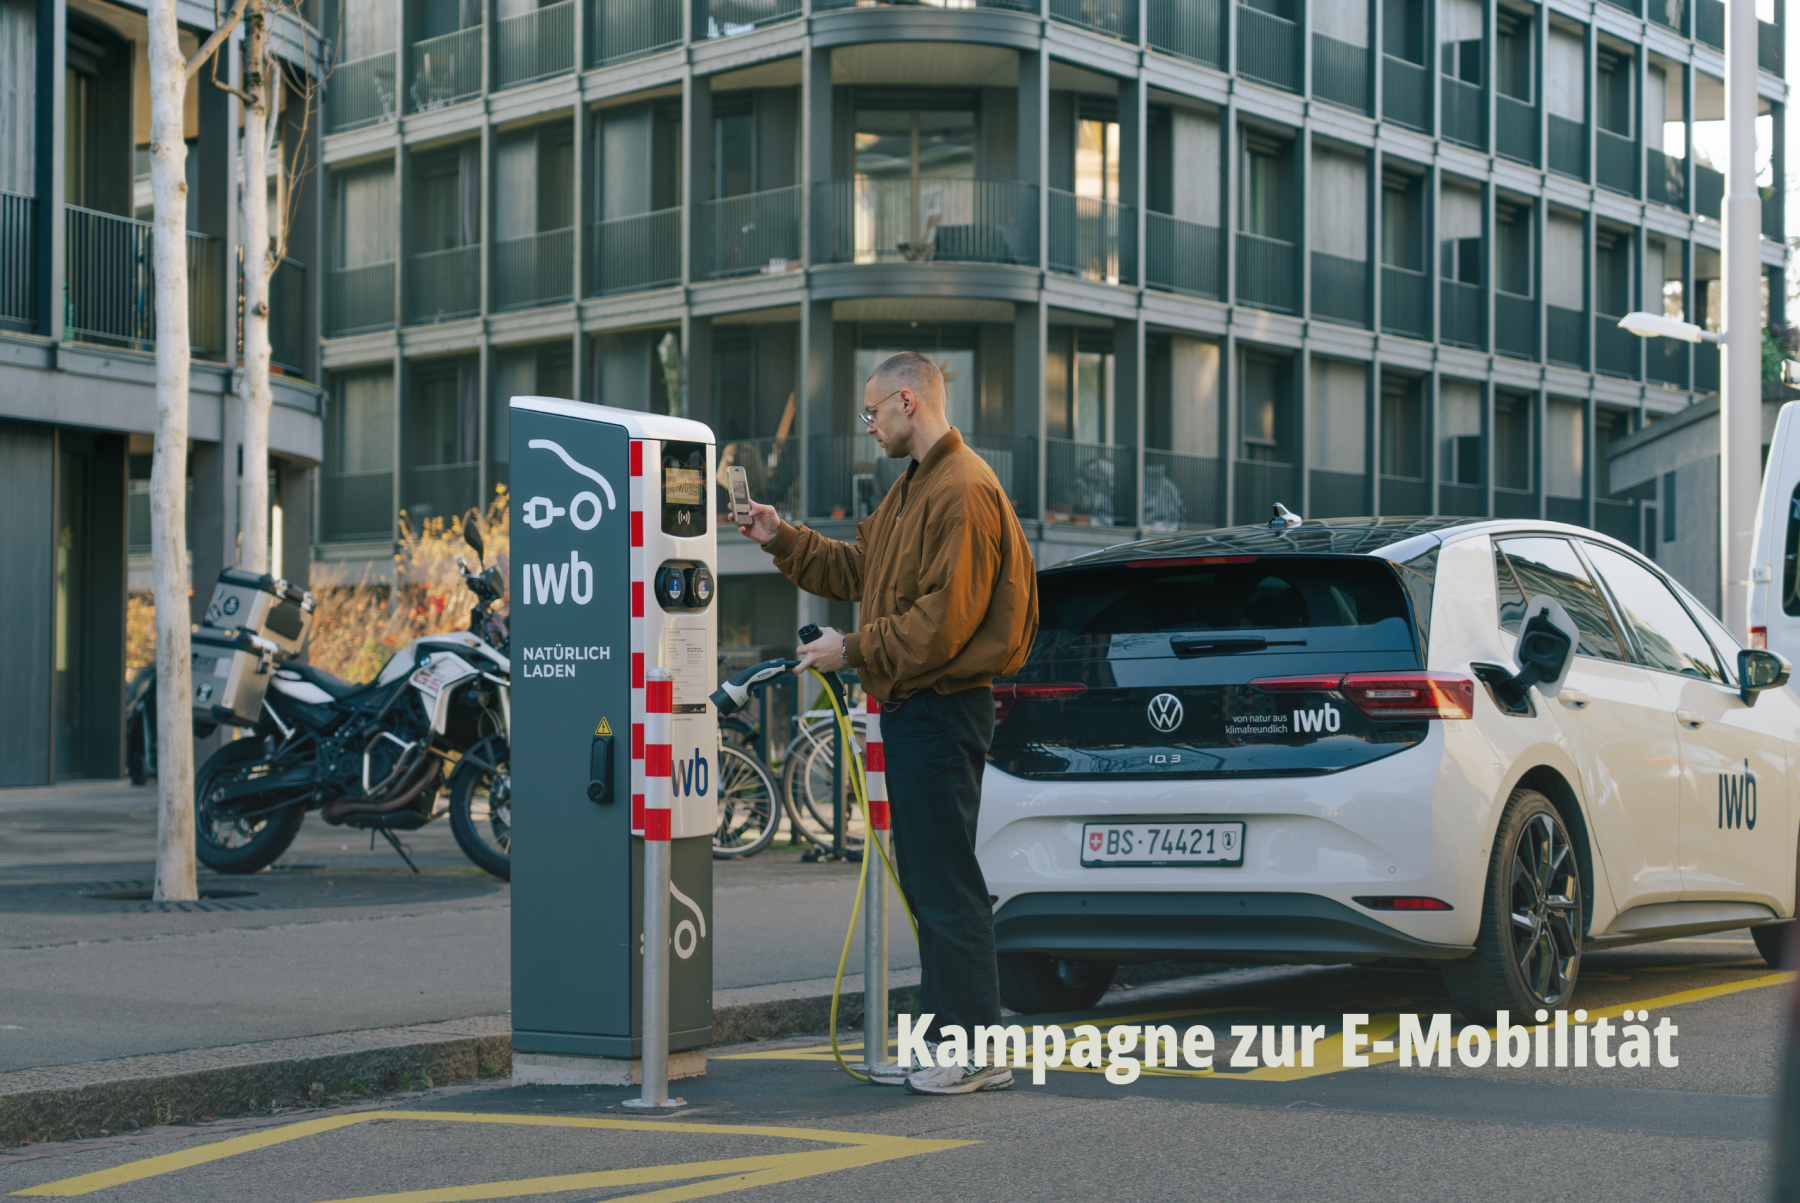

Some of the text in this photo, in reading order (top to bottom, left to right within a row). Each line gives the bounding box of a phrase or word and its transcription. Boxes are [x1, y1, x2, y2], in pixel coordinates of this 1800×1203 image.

[523, 644, 610, 660] NATÜRLICH
[523, 664, 576, 678] LADEN
[1232, 713, 1288, 723] von natur aus
[1225, 724, 1288, 734] klimafreundlich
[671, 747, 708, 797] wb
